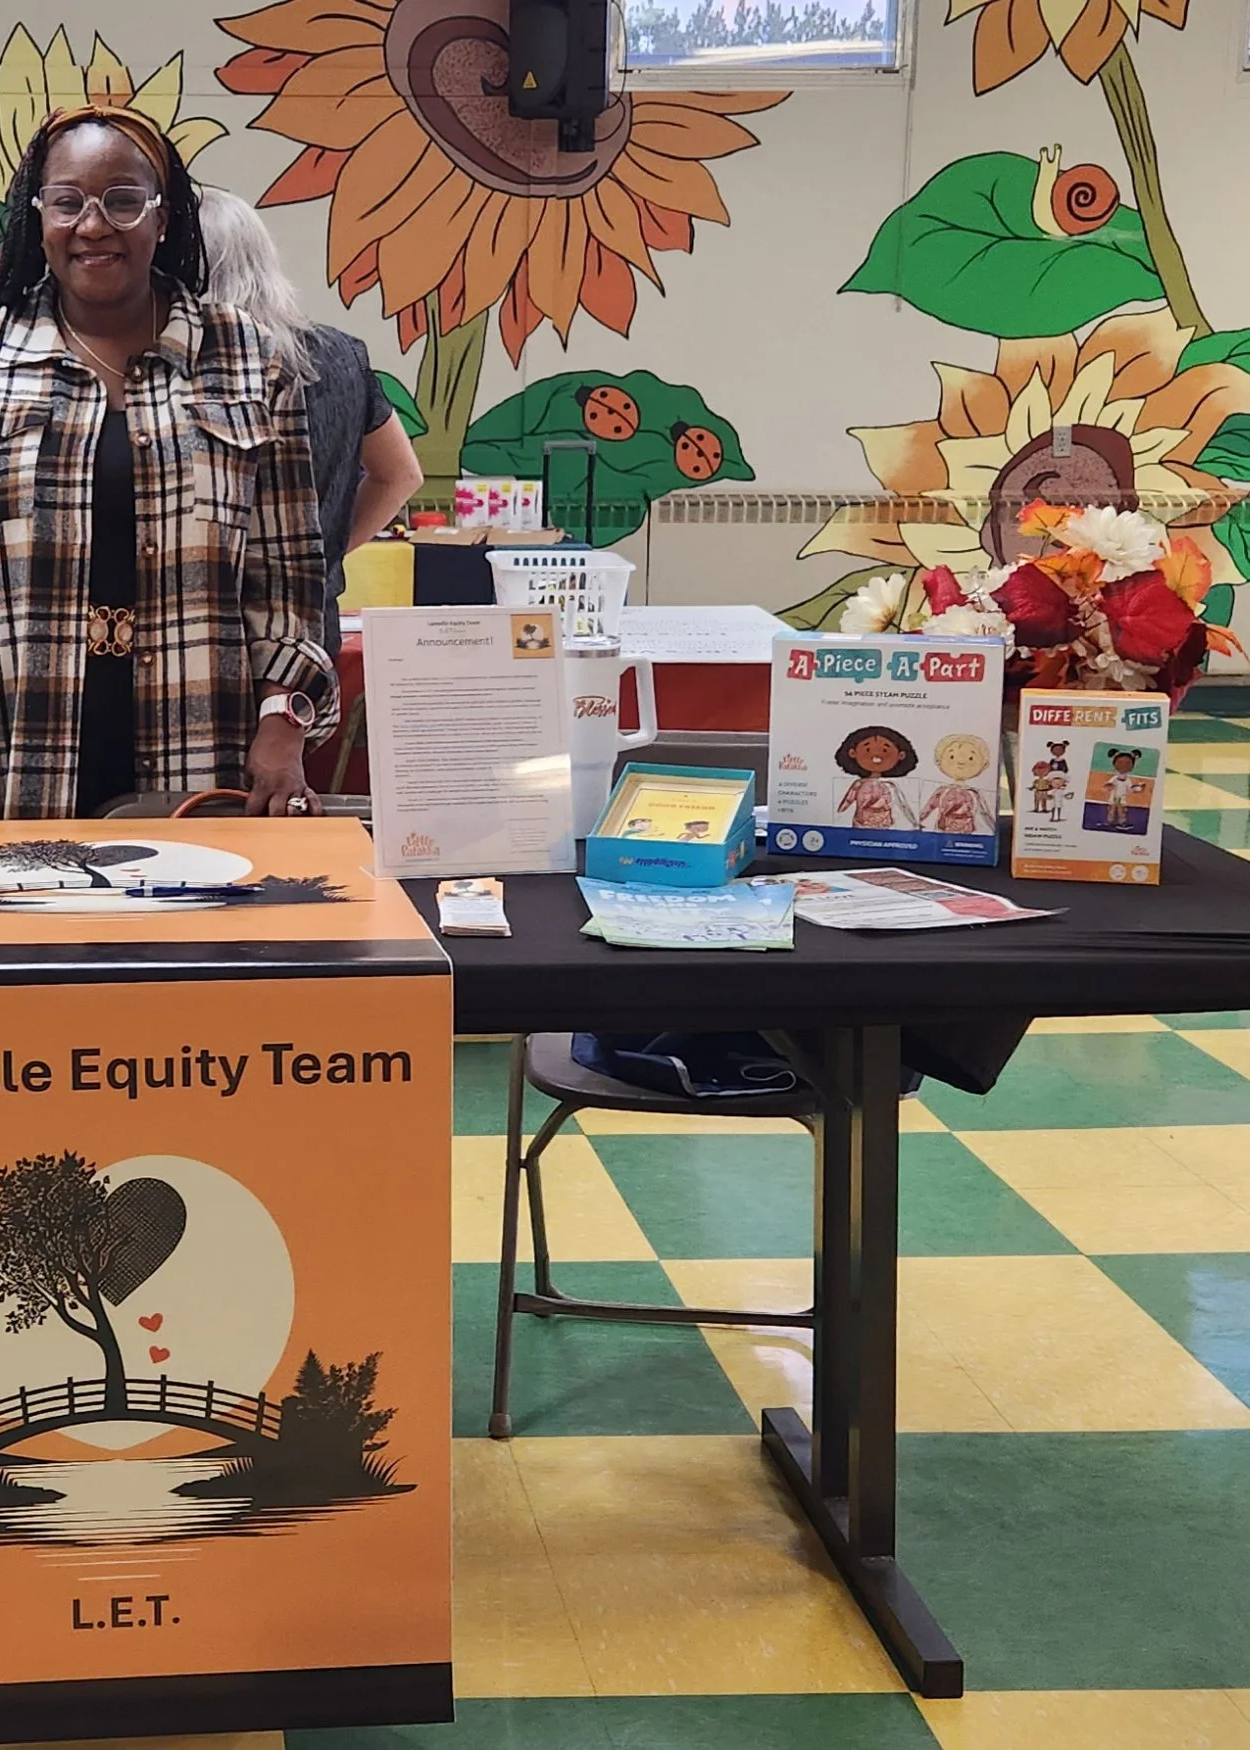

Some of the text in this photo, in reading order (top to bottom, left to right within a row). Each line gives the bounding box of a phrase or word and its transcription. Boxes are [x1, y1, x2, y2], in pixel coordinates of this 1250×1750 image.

[416, 636, 494, 647] Announcement!
[794, 654, 983, 678] A Piece A Part
[1128, 711, 1159, 725] FITS
[597, 888, 738, 904] FREEDOM
[70, 1045, 249, 1099] Equity
[261, 1043, 412, 1085] Team
[72, 1594, 181, 1629] L.E.T.
